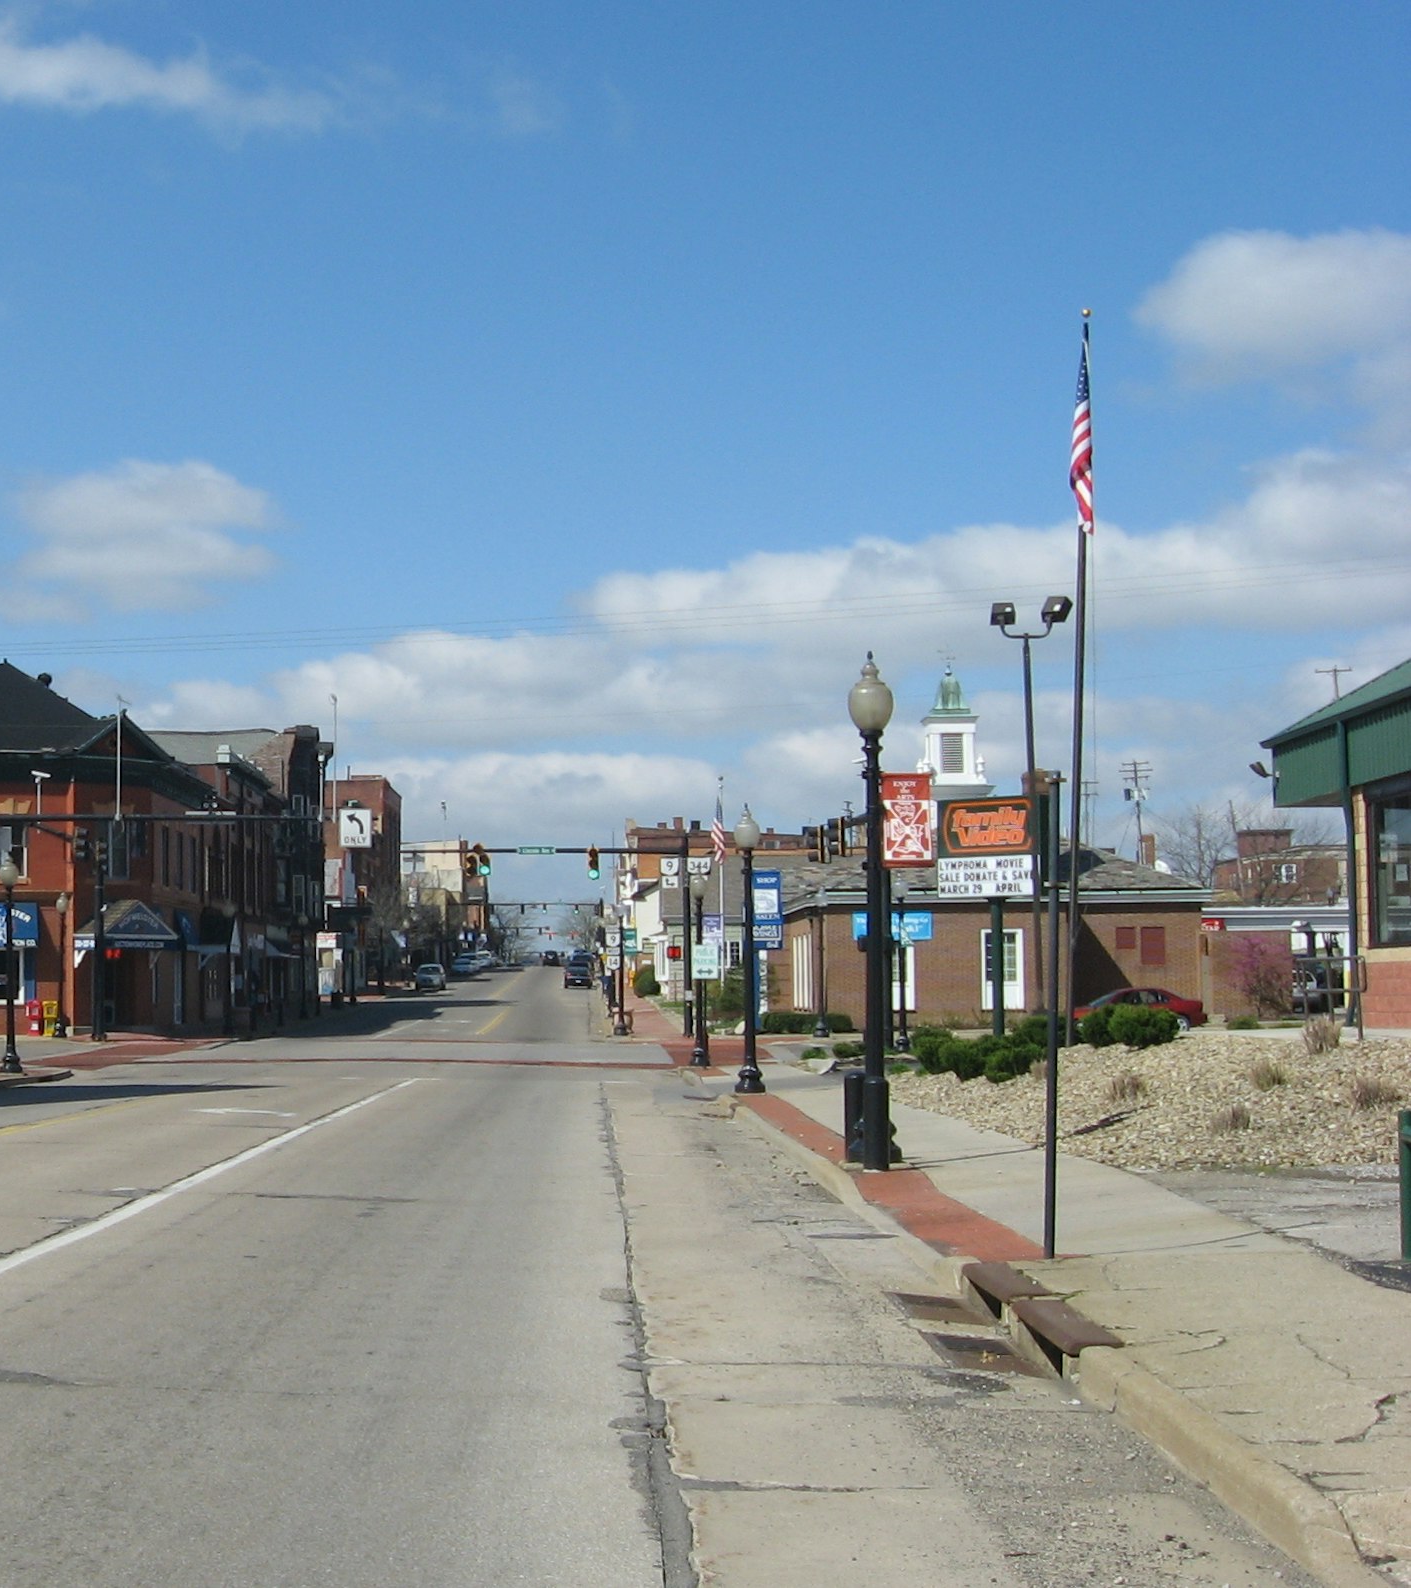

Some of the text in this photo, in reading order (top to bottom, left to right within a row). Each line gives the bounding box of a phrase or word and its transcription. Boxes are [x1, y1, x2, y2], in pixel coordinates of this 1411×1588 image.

[952, 806, 1026, 829] family
[343, 836, 367, 845] ONLY
[951, 825, 1025, 847] Video
[666, 861, 673, 871] 9
[689, 861, 708, 871] 344
[939, 859, 1024, 871] LYMPHOMA MOVIE
[939, 873, 961, 882] SALE
[964, 871, 997, 881] DONATE
[1002, 871, 1008, 880] &
[940, 883, 1022, 894] MARCH 29 APRIL
[610, 935, 617, 943] 9
[609, 957, 618, 966] 14
